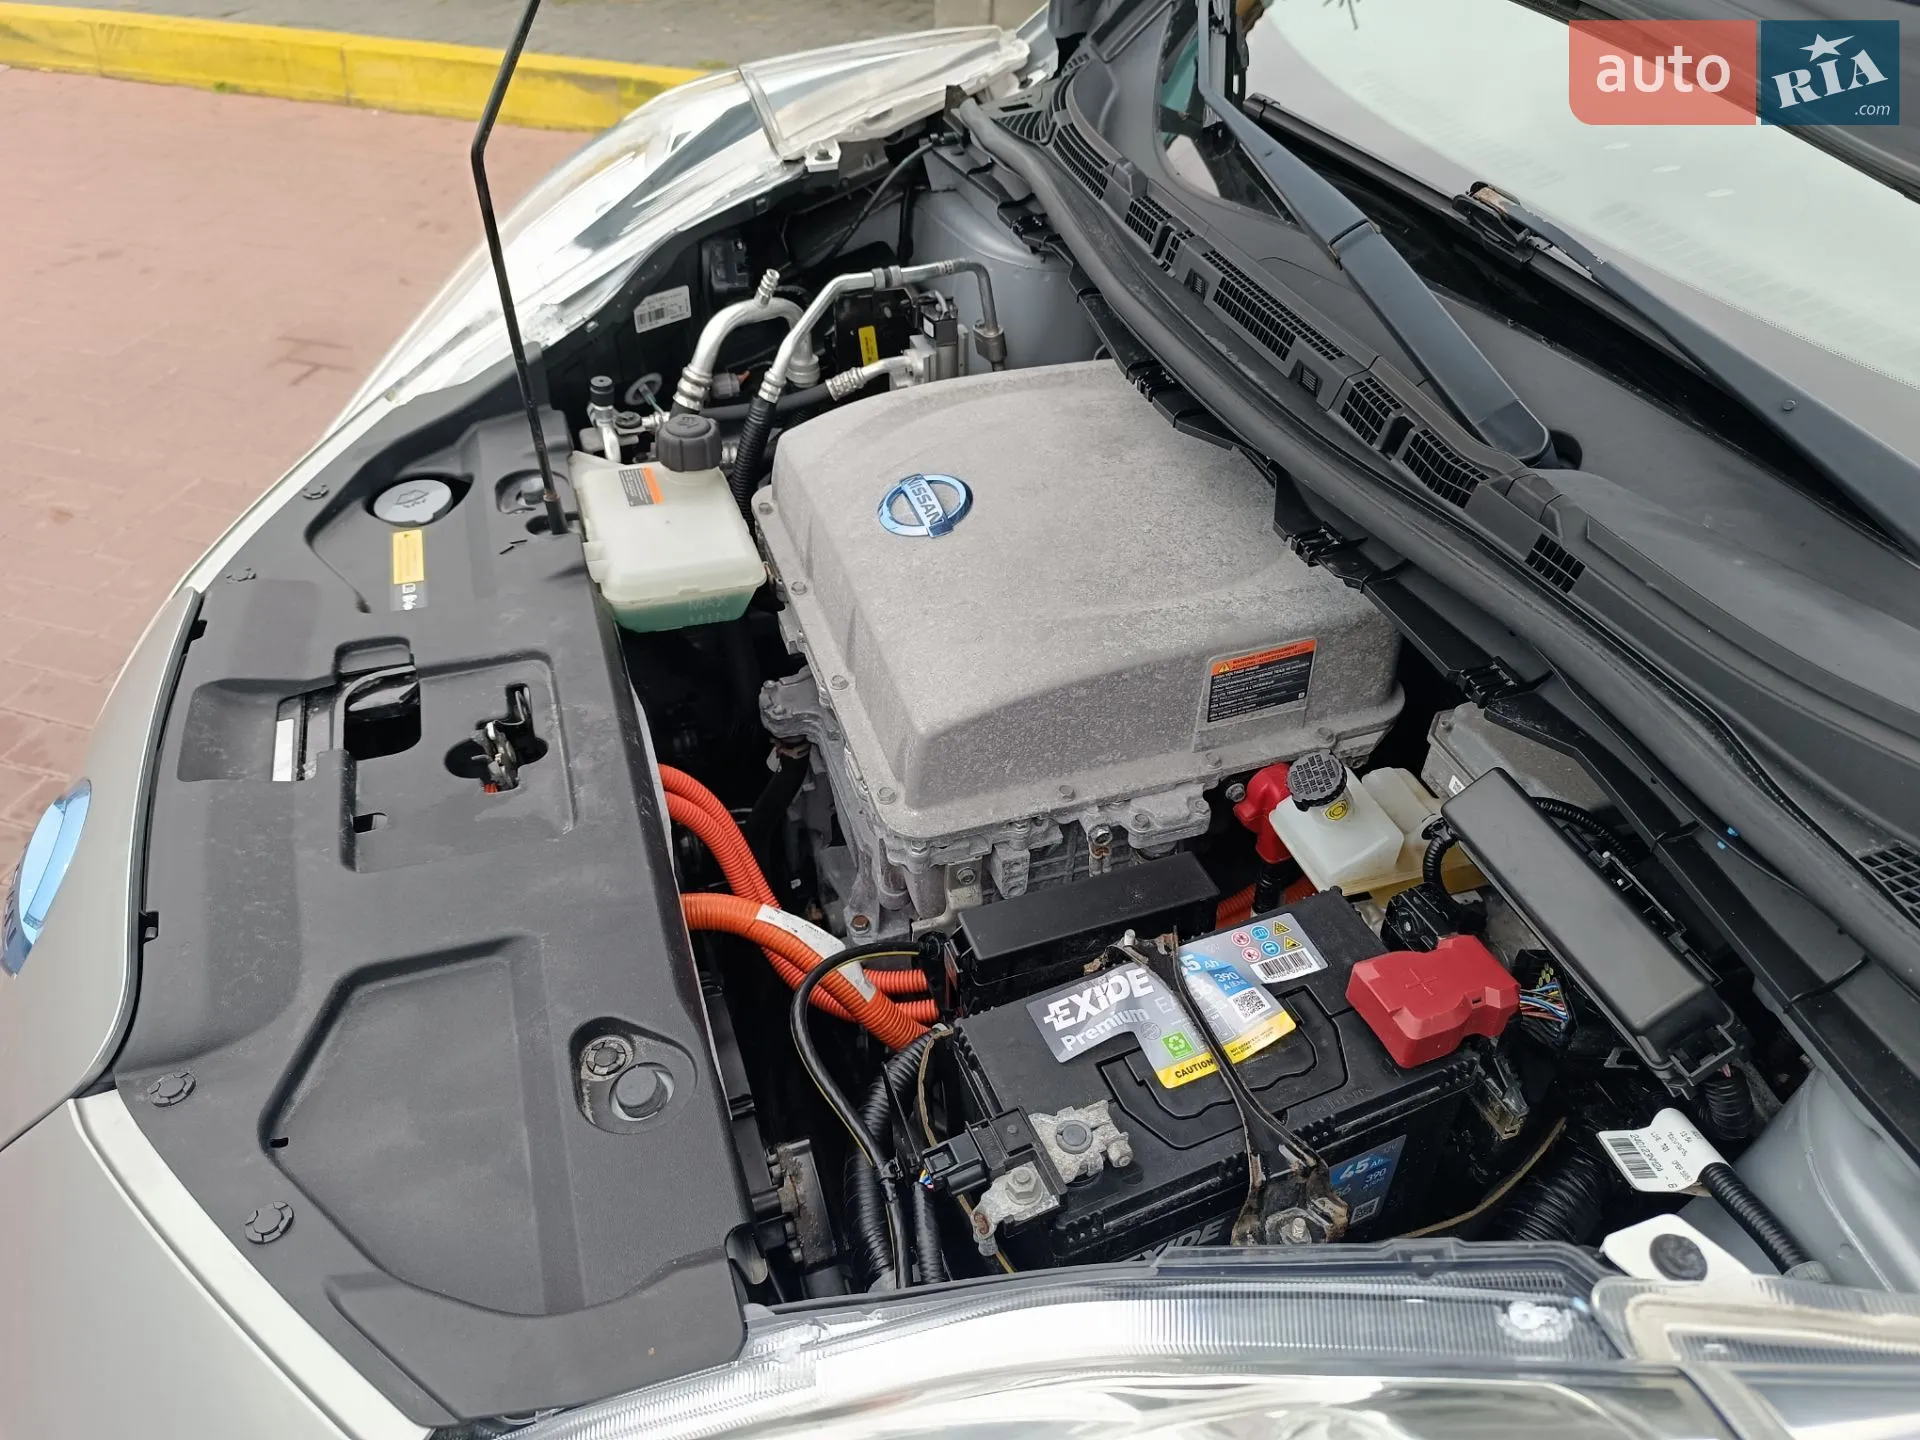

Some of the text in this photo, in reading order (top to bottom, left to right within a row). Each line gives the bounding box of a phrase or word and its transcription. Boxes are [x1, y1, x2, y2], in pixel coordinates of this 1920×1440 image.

[907, 477, 944, 526] NISSAN
[689, 595, 729, 611] MAX
[689, 611, 731, 624] MIN
[1214, 971, 1240, 983] 390
[1043, 967, 1155, 1032] EXIDE
[1060, 1008, 1150, 1051] Premium
[1174, 1058, 1214, 1079] CAUTION
[1364, 1167, 1387, 1183] 390
